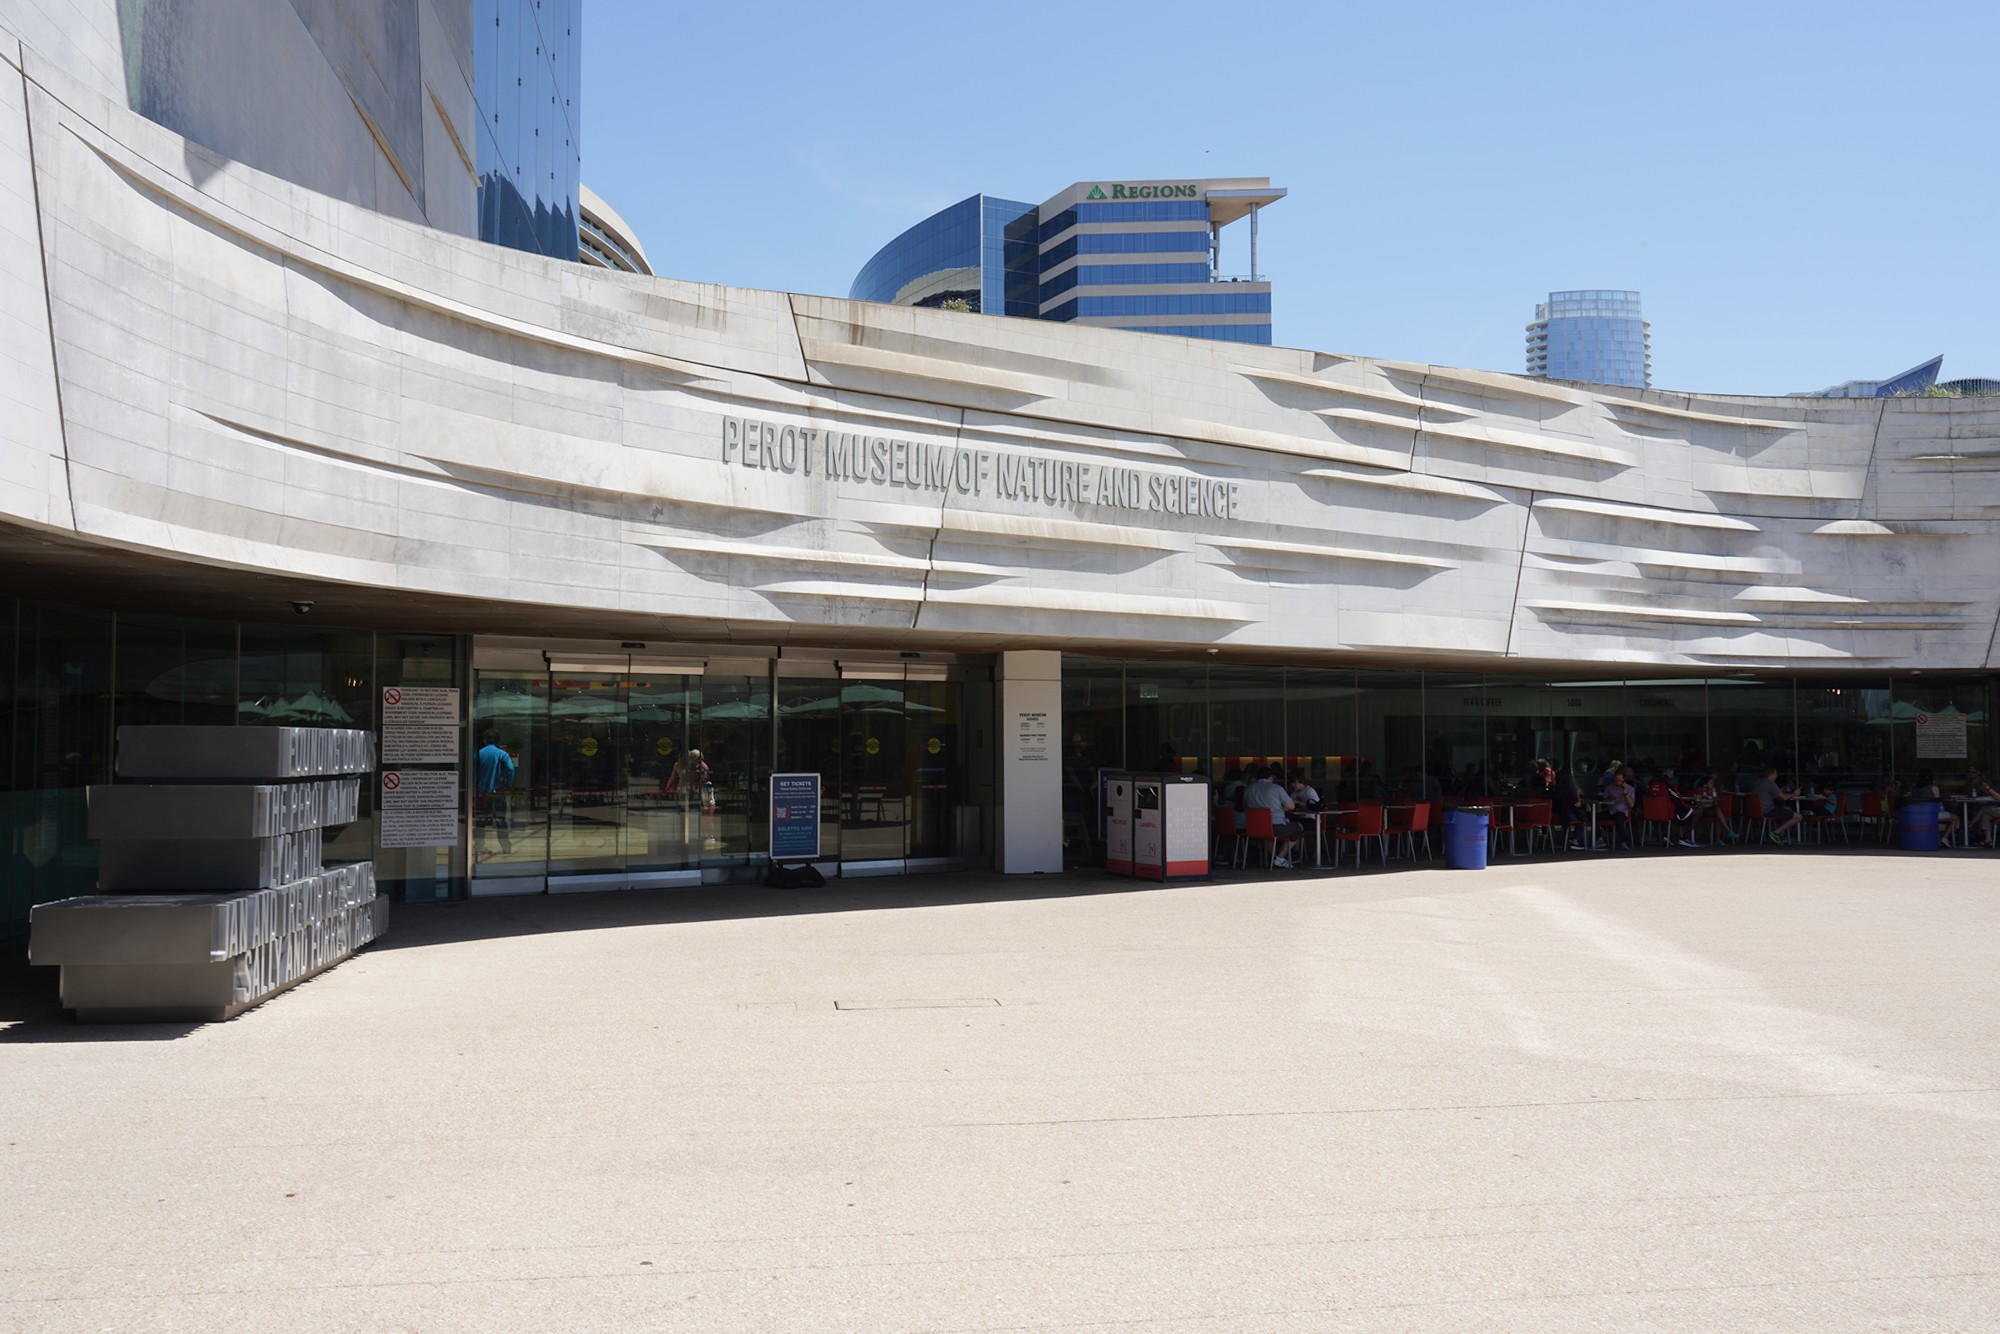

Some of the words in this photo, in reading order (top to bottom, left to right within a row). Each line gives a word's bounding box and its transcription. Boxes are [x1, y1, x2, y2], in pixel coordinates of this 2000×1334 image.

[1112, 184, 1197, 199] REGIONS
[723, 416, 816, 476] PEROT
[825, 431, 949, 492] MUSEUM
[953, 449, 990, 496] OF
[997, 453, 1092, 505] NATURE
[1098, 466, 1144, 509] AND
[1149, 472, 1240, 520] SCIENCE
[1142, 687, 1157, 697] EXIT
[290, 781, 324, 833] PEROT
[302, 826, 324, 878] HILL
[252, 890, 278, 950] AND
[234, 935, 283, 1004] SALLY
[285, 927, 307, 983] AND
